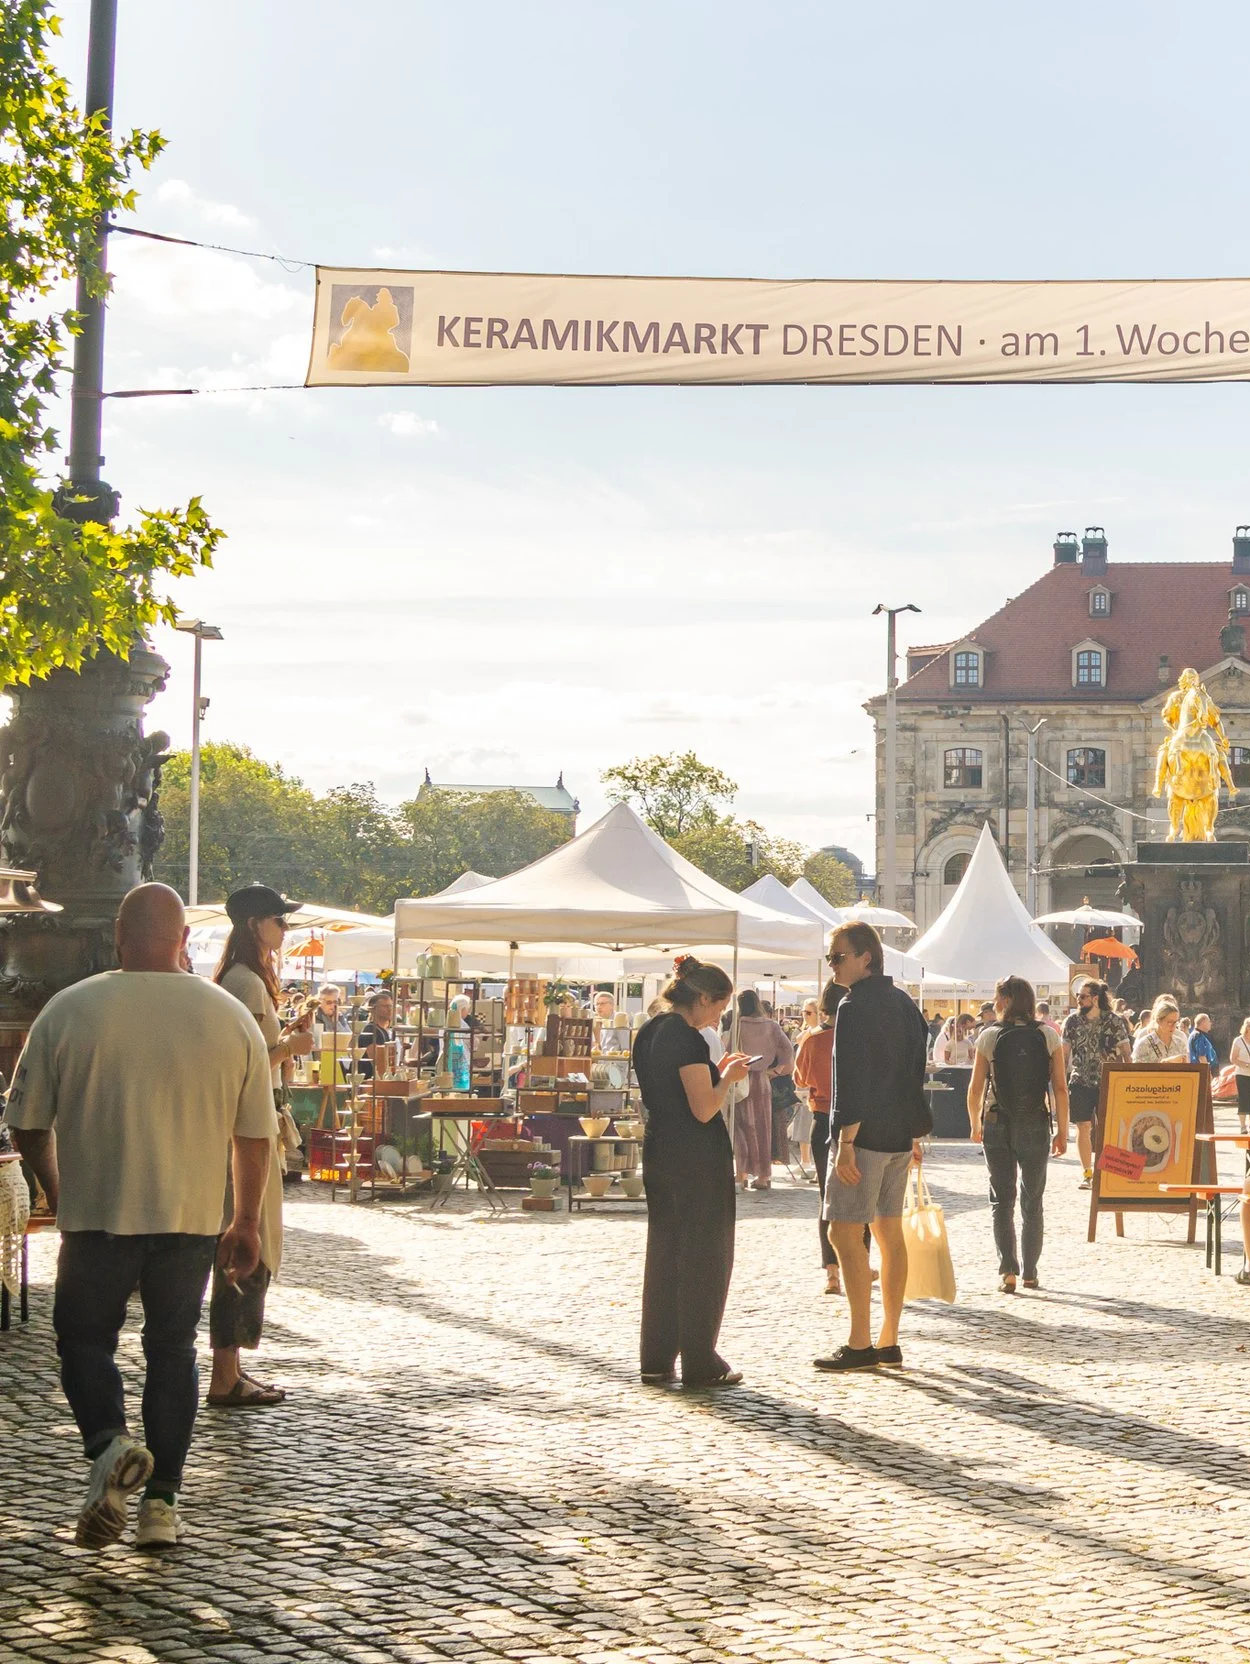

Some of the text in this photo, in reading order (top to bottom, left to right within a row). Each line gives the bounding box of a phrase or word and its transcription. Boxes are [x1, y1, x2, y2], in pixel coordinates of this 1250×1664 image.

[436, 315, 769, 356] KERAMIKMARKT
[781, 324, 963, 357] DRESDEN
[1000, 331, 1060, 356] am
[1075, 324, 1107, 356] 1.
